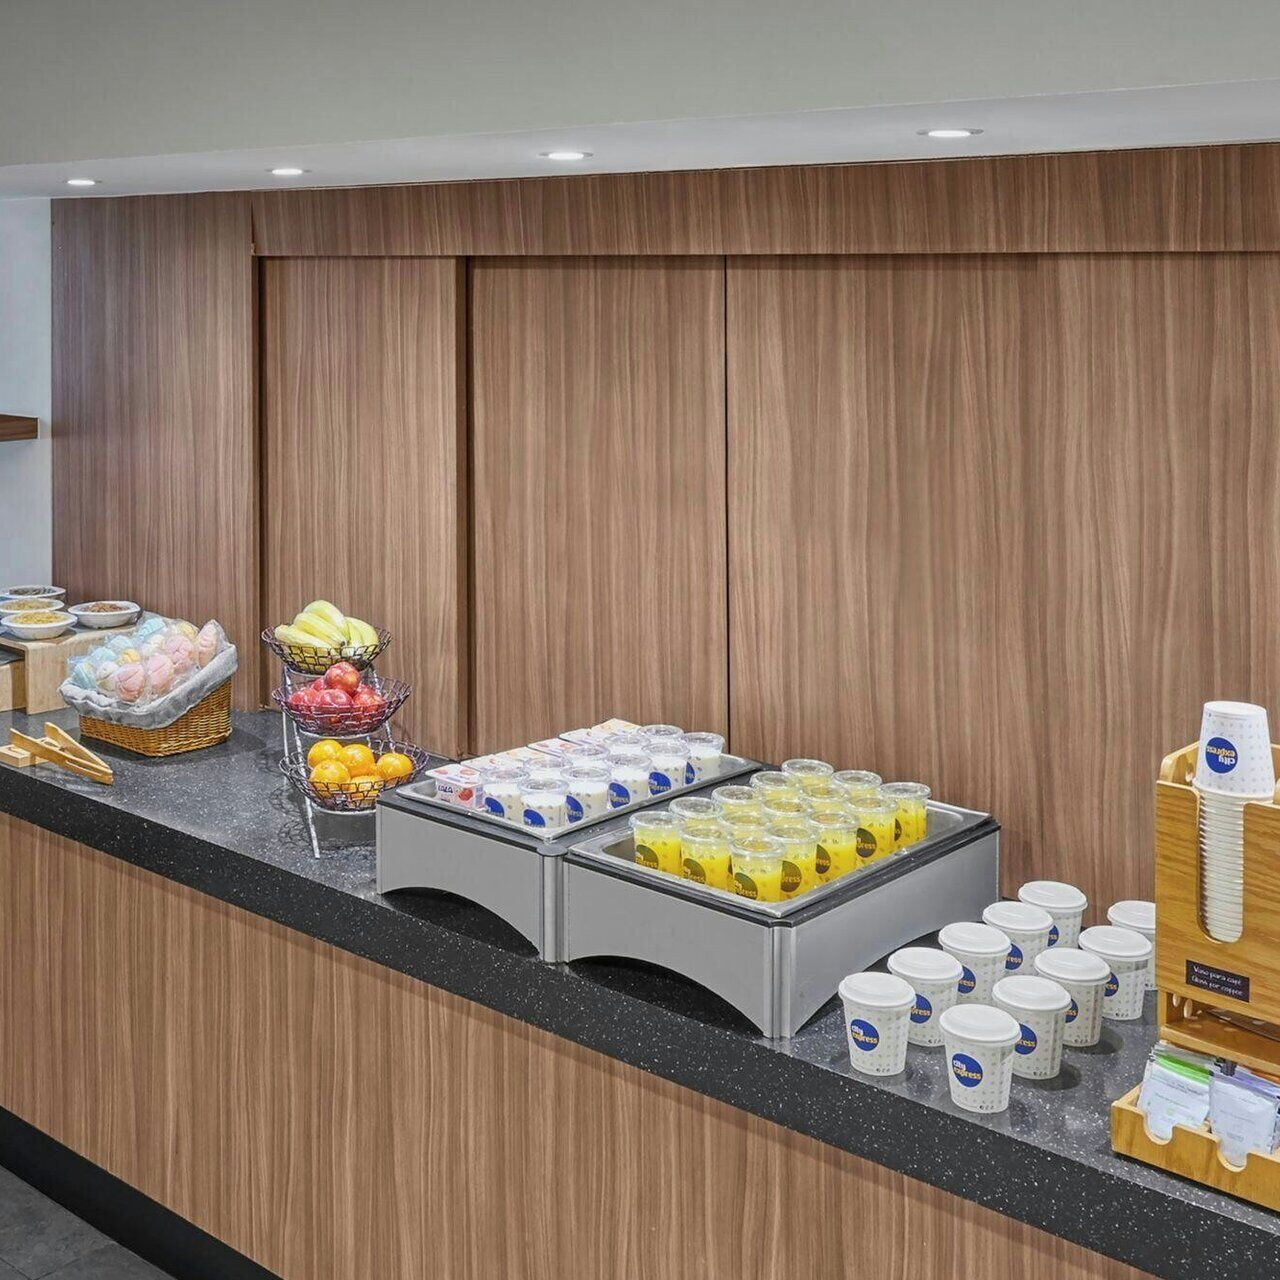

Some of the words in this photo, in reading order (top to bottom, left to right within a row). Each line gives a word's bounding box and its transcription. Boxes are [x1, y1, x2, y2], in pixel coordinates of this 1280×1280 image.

[1206, 745, 1235, 758] express
[1219, 754, 1235, 766] city
[1006, 955, 1022, 965] ress
[959, 979, 976, 989] ress
[911, 1005, 932, 1017] press
[851, 1025, 864, 1036] city
[851, 1031, 879, 1044] express
[1019, 1038, 1036, 1048] ress
[952, 1059, 967, 1071] city
[953, 1066, 981, 1081] express
